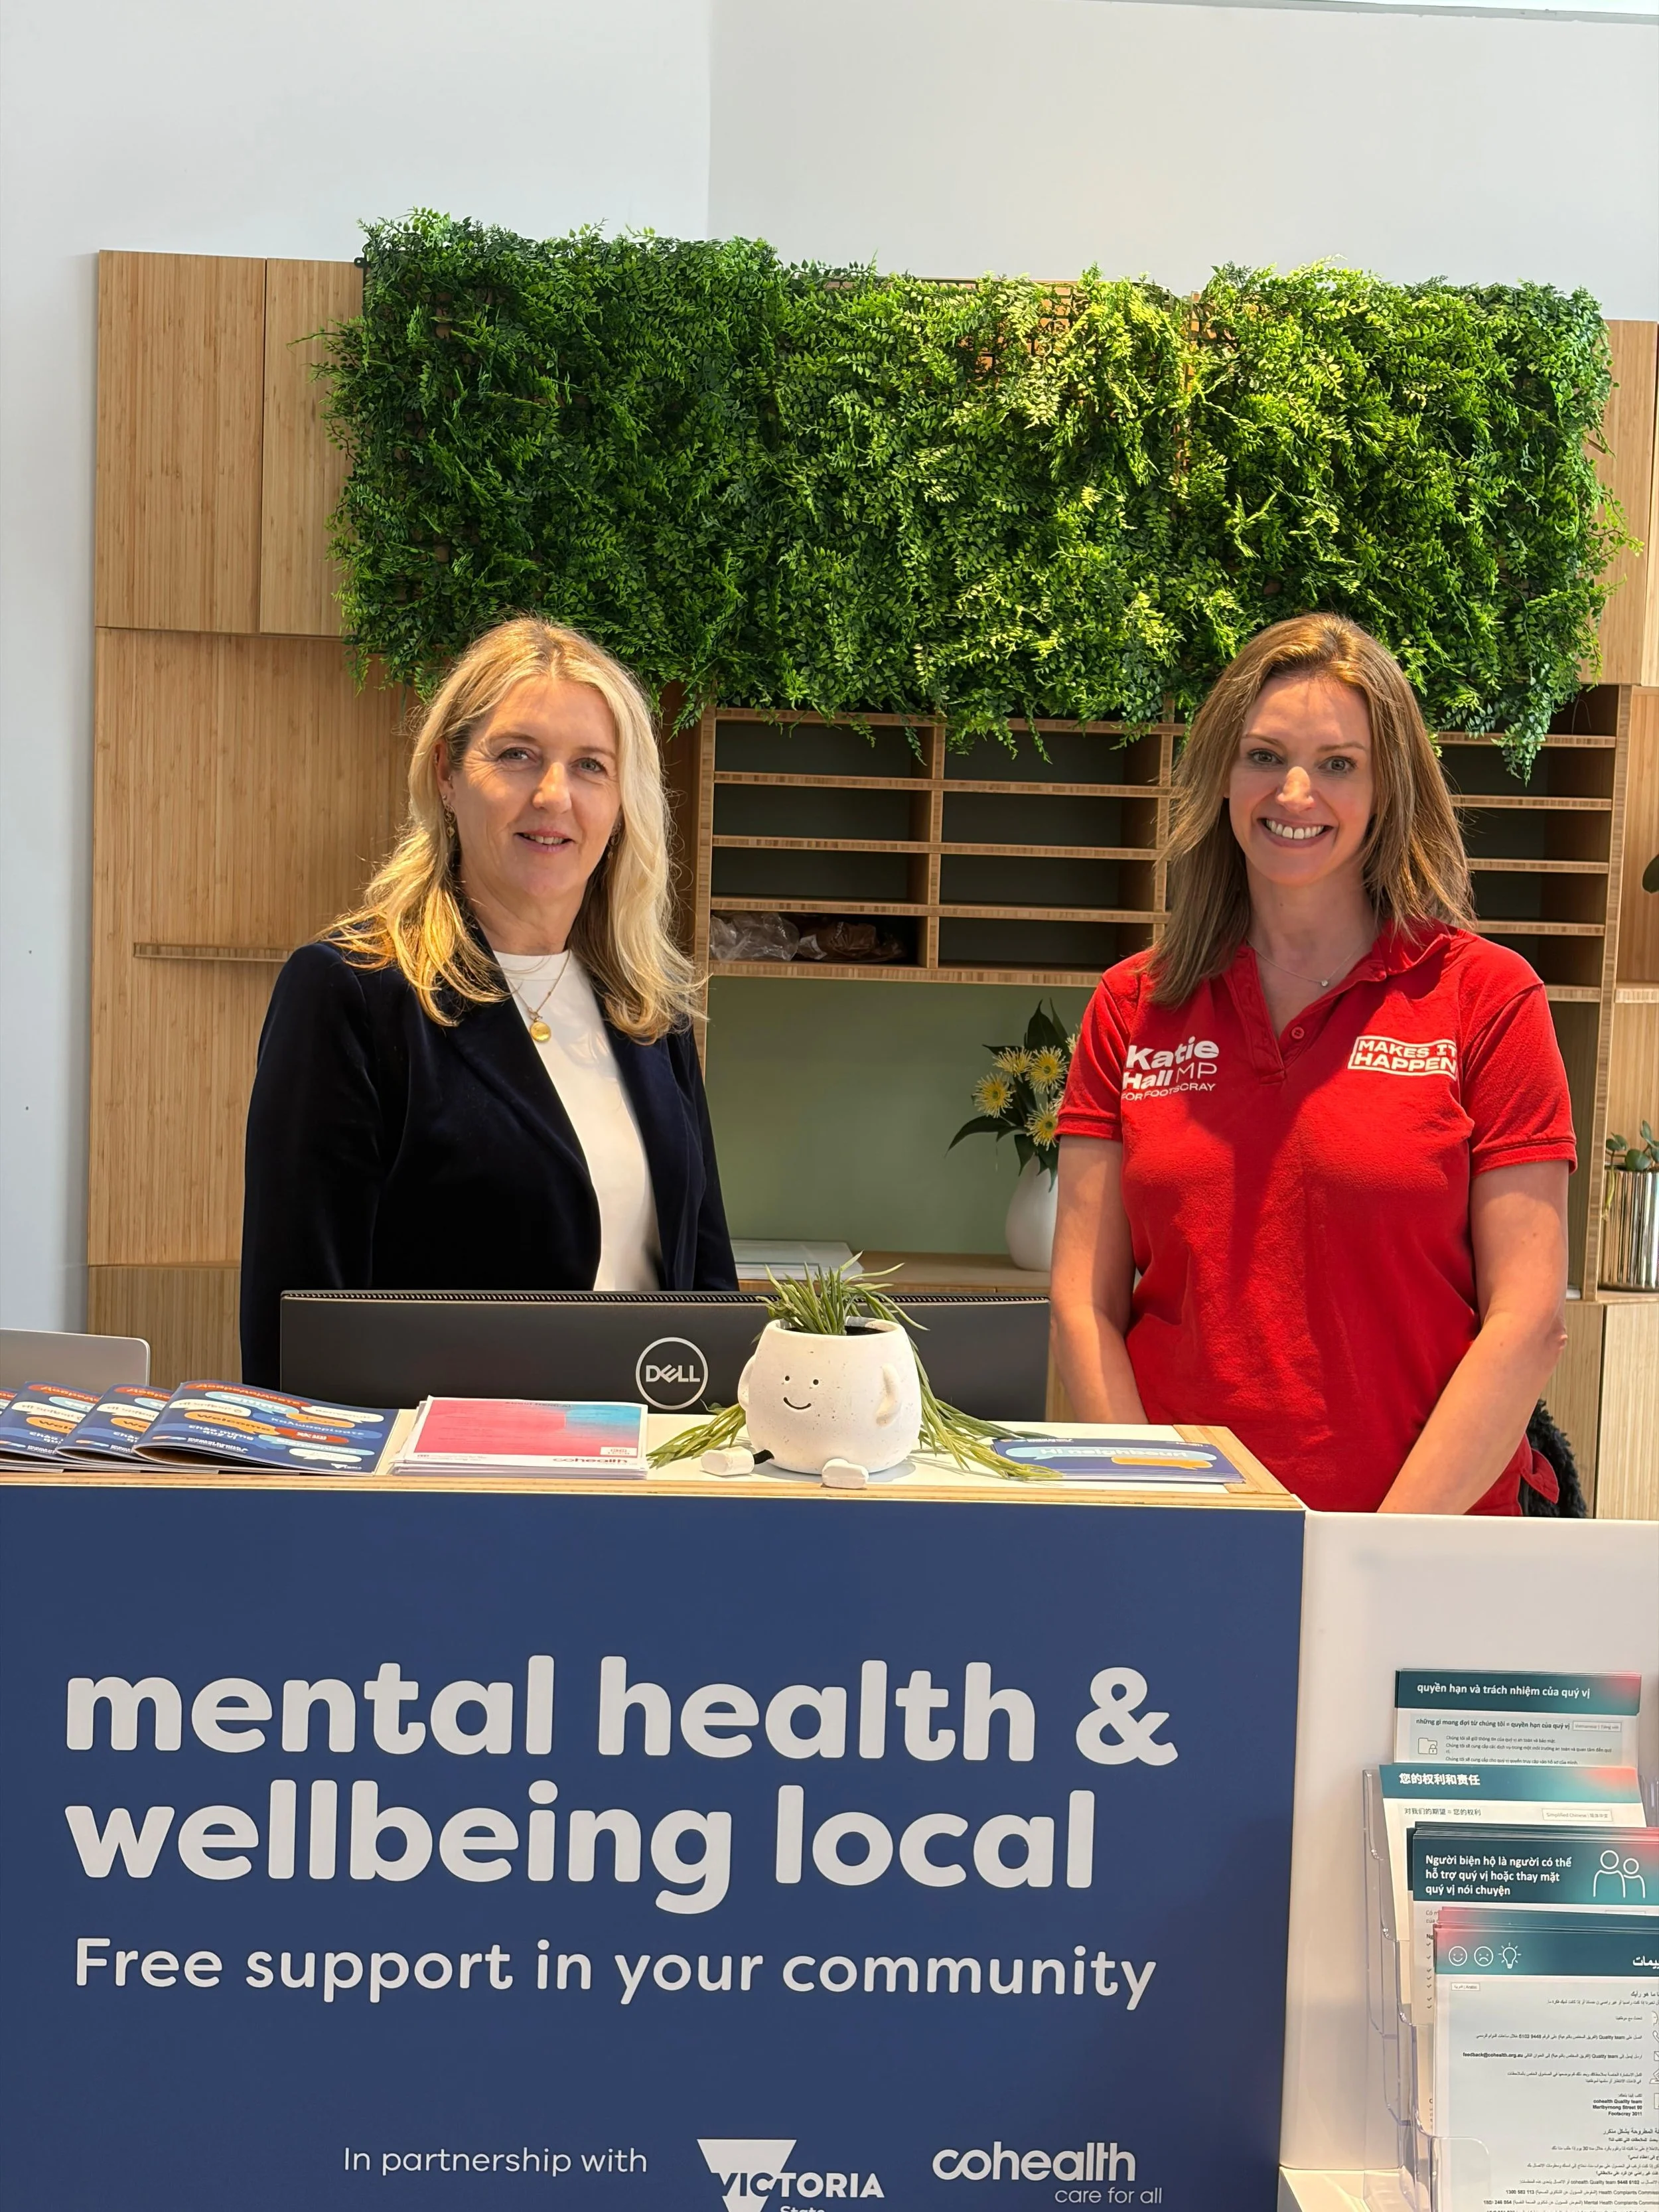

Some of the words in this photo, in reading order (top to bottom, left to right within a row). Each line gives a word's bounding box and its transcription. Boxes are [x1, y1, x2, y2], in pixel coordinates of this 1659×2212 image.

[1126, 1036, 1219, 1070] Katie
[1358, 1041, 1429, 1058] MAKES
[1437, 1044, 1457, 1057] IT
[1354, 1053, 1457, 1074] HAPPEN
[1122, 1070, 1173, 1090] Hall
[1176, 1062, 1217, 1083] MP
[1144, 1082, 1216, 1098] FOOTSCRAY
[646, 1364, 700, 1382] DELL
[197, 1414, 271, 1432] Welcome
[1417, 1682, 1447, 1694] quyền
[1449, 1684, 1467, 1694] hạn
[1470, 1684, 1480, 1693] và
[1483, 1685, 1507, 1694] trách
[1510, 1686, 1540, 1696] nhiệm
[1542, 1686, 1559, 1696] của
[1561, 1688, 1579, 1699] quý
[1582, 1688, 1590, 1699] vị
[67, 1655, 553, 1755] mental
[599, 1657, 1035, 1761] health
[1076, 1667, 1178, 1765] &
[1399, 1773, 1480, 1785] 您的权利和责任
[65, 1780, 731, 1914] wellbeing
[776, 1785, 1094, 1887] local
[1425, 1854, 1457, 1866] Người
[1459, 1855, 1480, 1867] biện
[1483, 1856, 1496, 1867] hộ
[1498, 1856, 1507, 1866] là
[1510, 1857, 1539, 1868] người
[1542, 1857, 1553, 1867] có
[1555, 1856, 1572, 1867] thể
[1425, 1867, 1439, 1879] hỗ
[1440, 1870, 1457, 1881] trợ
[1459, 1870, 1477, 1881] quý
[1479, 1870, 1488, 1881] vị
[1490, 1870, 1514, 1882] hoặc
[1516, 1871, 1538, 1883] thay
[1540, 1872, 1560, 1883] mặt
[1425, 1883, 1444, 1895] quý
[1446, 1884, 1455, 1895] vị
[1457, 1884, 1473, 1894] nói
[1475, 1885, 1510, 1897] chuyện
[77, 1939, 222, 1987] Free
[246, 1945, 512, 2002] support
[538, 1940, 591, 1989] in
[615, 1955, 762, 2004] your
[783, 1946, 1156, 2010] community
[345, 2148, 370, 2170] In
[383, 2148, 571, 2176] partnership
[581, 2148, 646, 2172] with
[933, 2142, 1135, 2181] cohealth
[715, 2172, 885, 2198] VICTORIA
[1055, 2191, 1101, 2203] care
[1108, 2187, 1134, 2203] for
[1141, 2188, 1161, 2203] all
